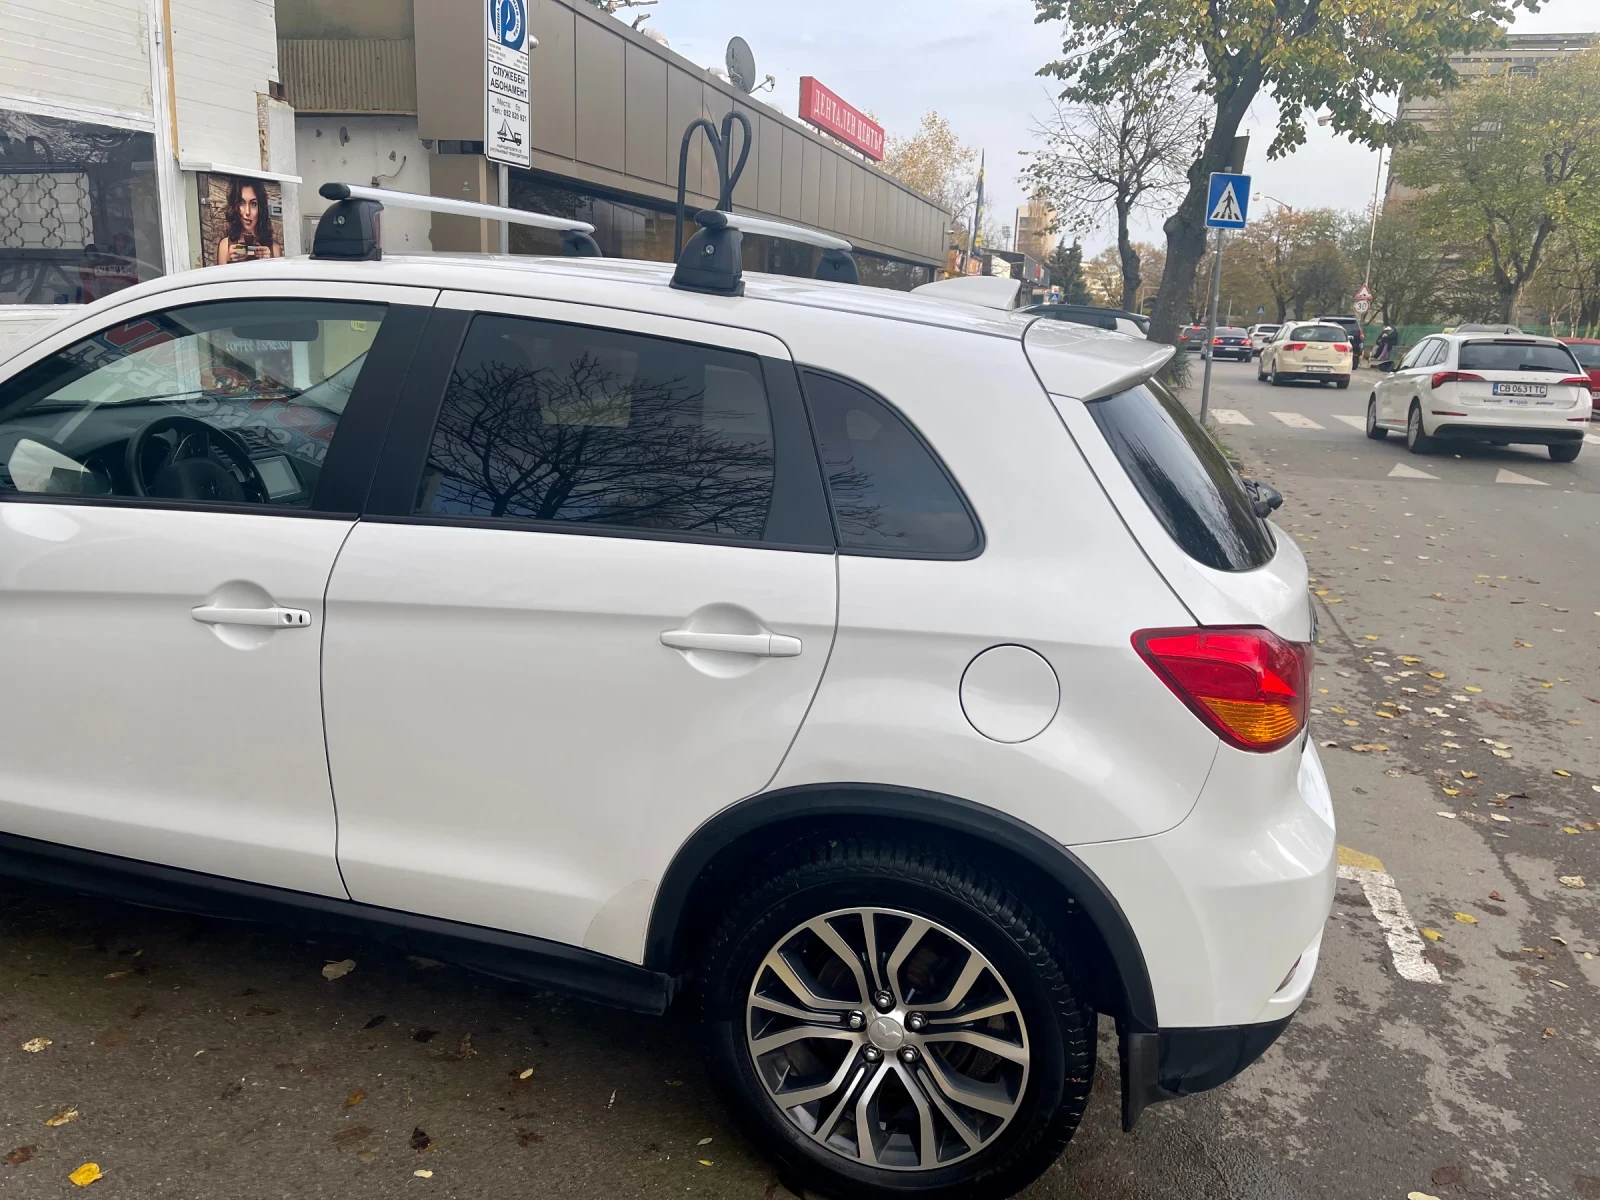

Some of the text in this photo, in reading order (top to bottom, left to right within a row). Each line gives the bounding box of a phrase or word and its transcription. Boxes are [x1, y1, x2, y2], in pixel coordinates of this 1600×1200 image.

[492, 65, 526, 85] СЛУЖЕБЕН
[490, 78, 528, 98] АБОНАМЕНТ
[814, 88, 883, 153] ДЕНТАЛЕН ЦЕНТЪР
[1512, 385, 1532, 393] 0631
